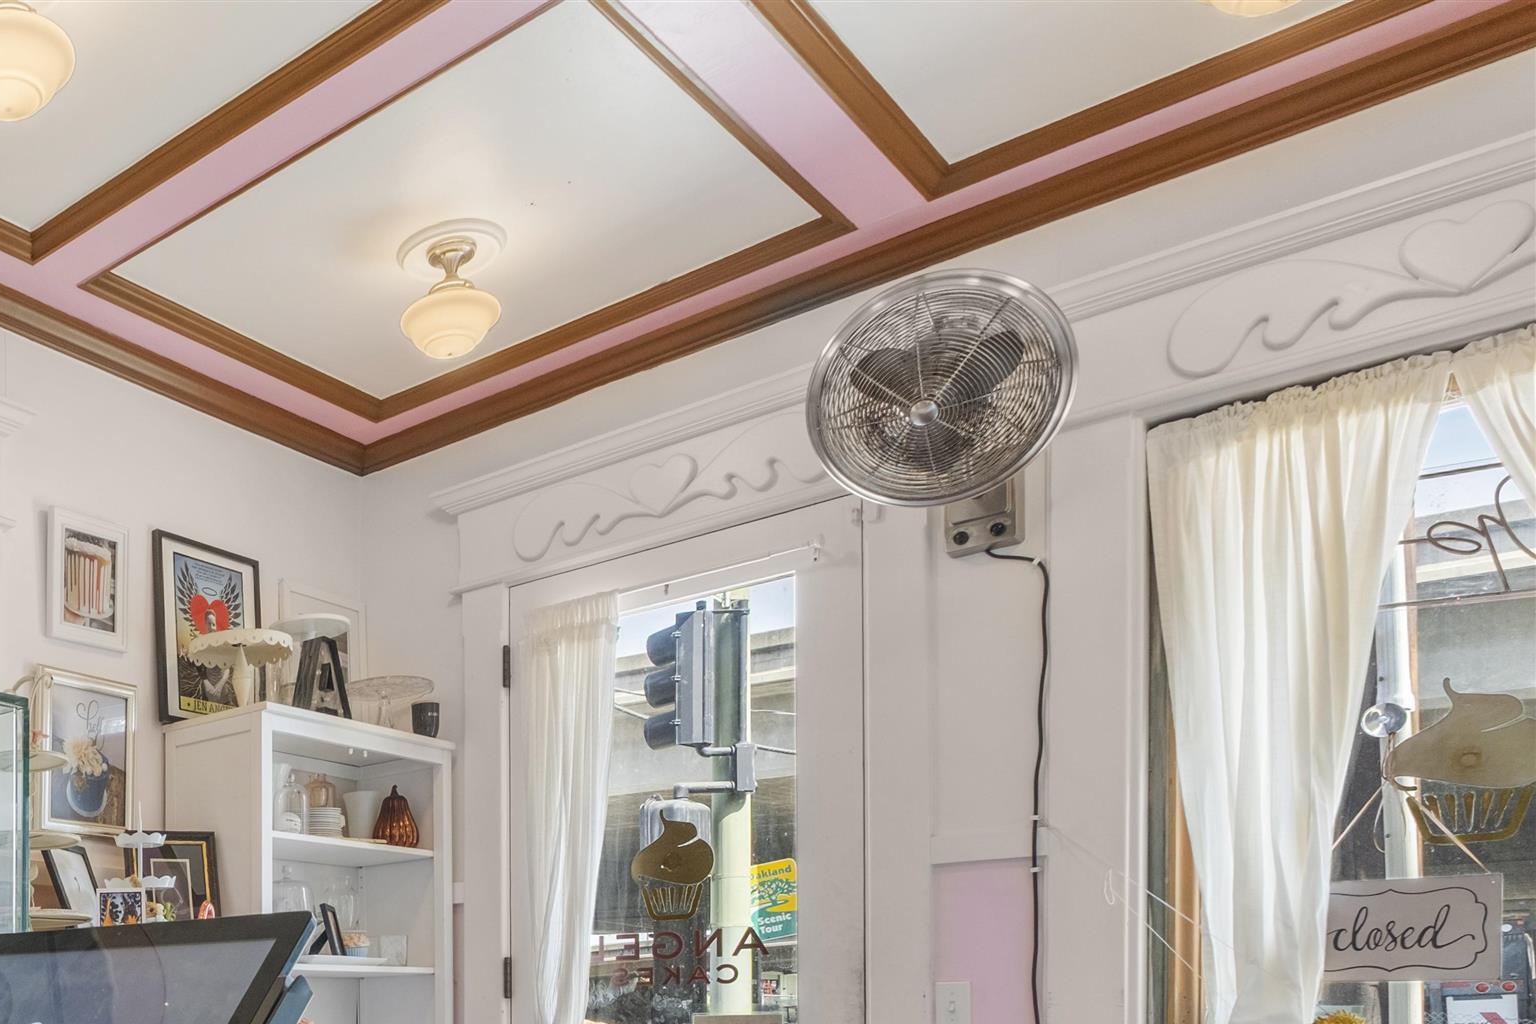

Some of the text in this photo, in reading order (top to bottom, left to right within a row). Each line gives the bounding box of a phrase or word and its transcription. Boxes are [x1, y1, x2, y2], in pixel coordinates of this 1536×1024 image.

[758, 912, 792, 926] Scenic
[759, 923, 784, 934] Tour
[1328, 903, 1476, 953] closed
